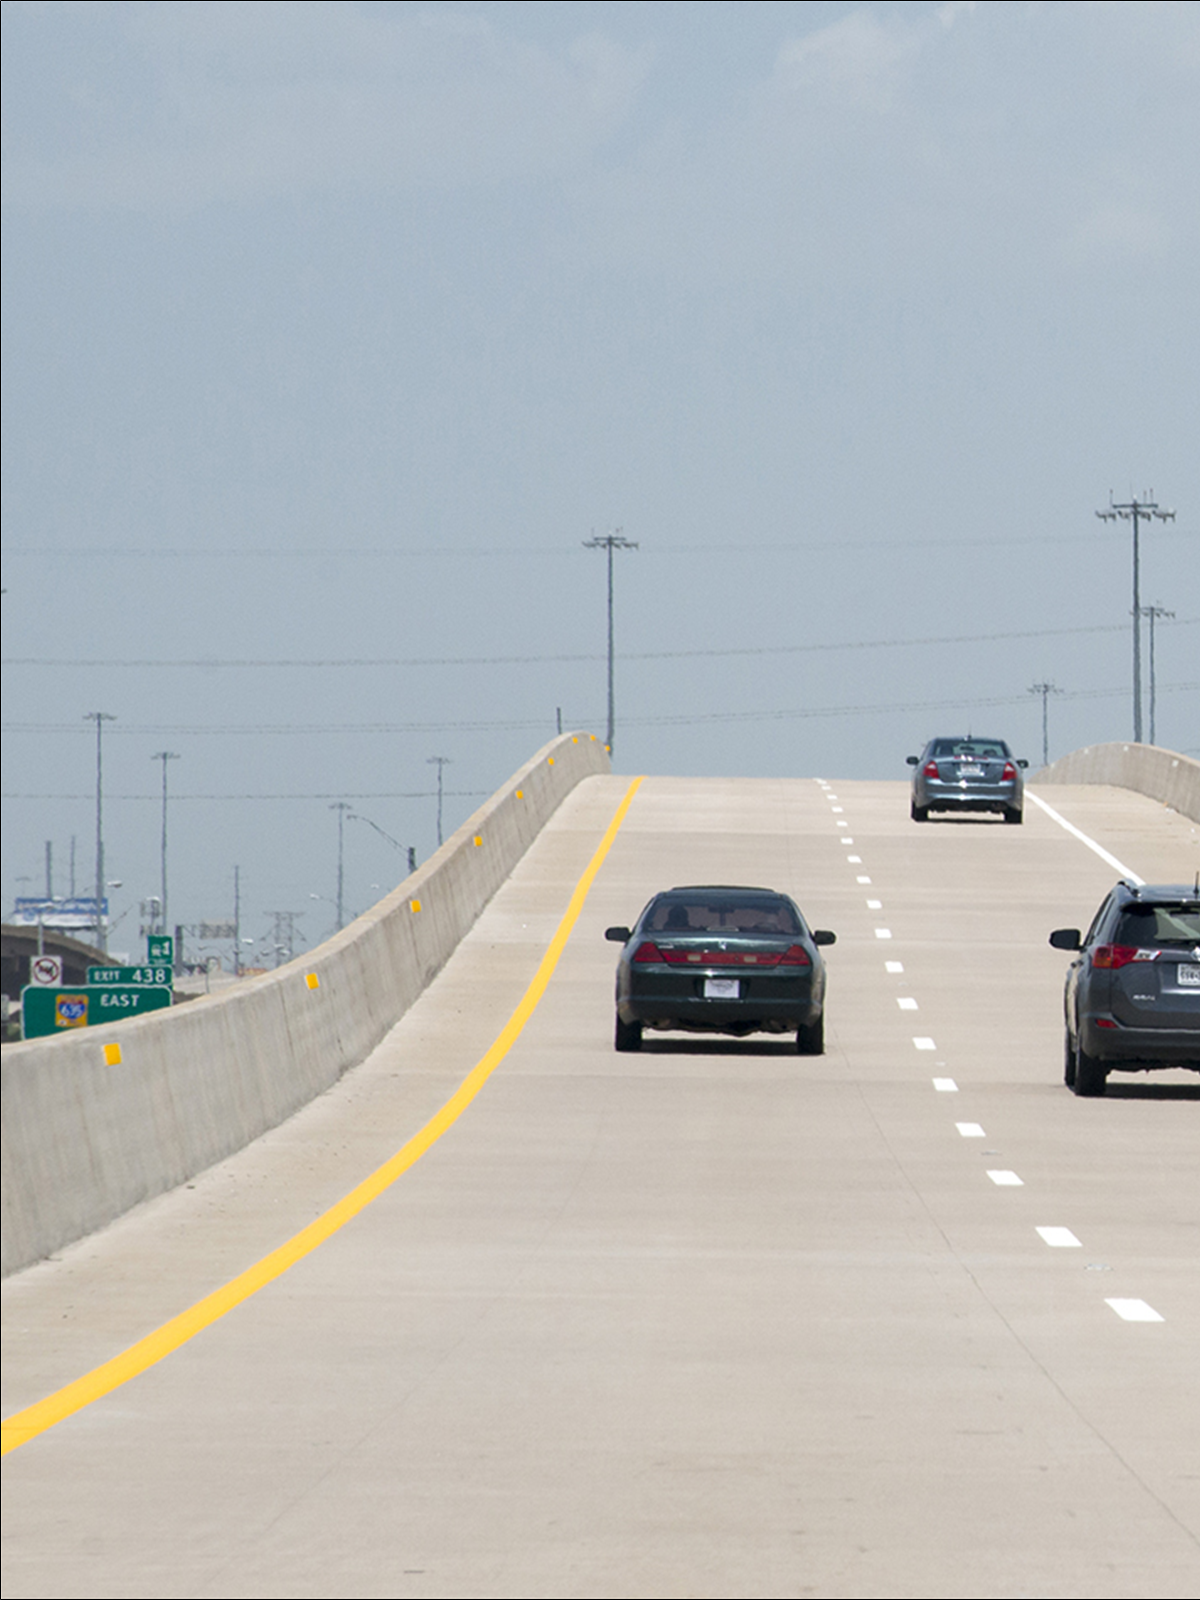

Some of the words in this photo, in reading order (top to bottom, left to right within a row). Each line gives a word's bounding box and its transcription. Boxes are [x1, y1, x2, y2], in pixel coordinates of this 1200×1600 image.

[94, 970, 120, 982] EXIT
[132, 968, 166, 983] 438
[60, 1004, 84, 1018] 635
[100, 993, 140, 1007] EAST
